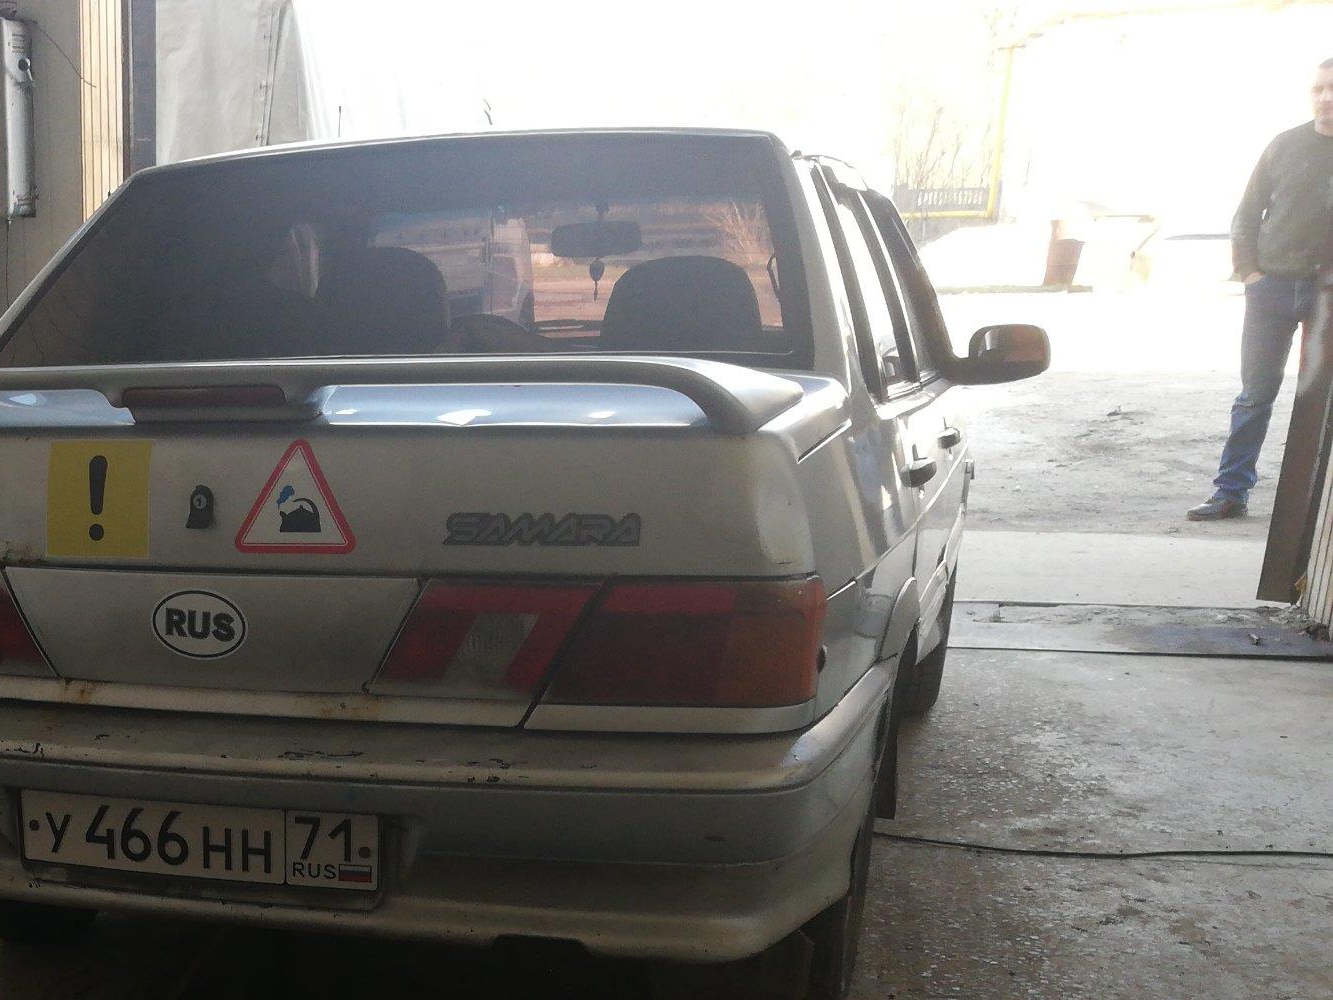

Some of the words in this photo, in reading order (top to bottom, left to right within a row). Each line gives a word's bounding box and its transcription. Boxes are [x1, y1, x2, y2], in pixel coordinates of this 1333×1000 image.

[442, 511, 643, 547] SAMARA
[164, 607, 236, 644] RUS
[294, 816, 353, 863] 71
[293, 861, 337, 881] RUS
